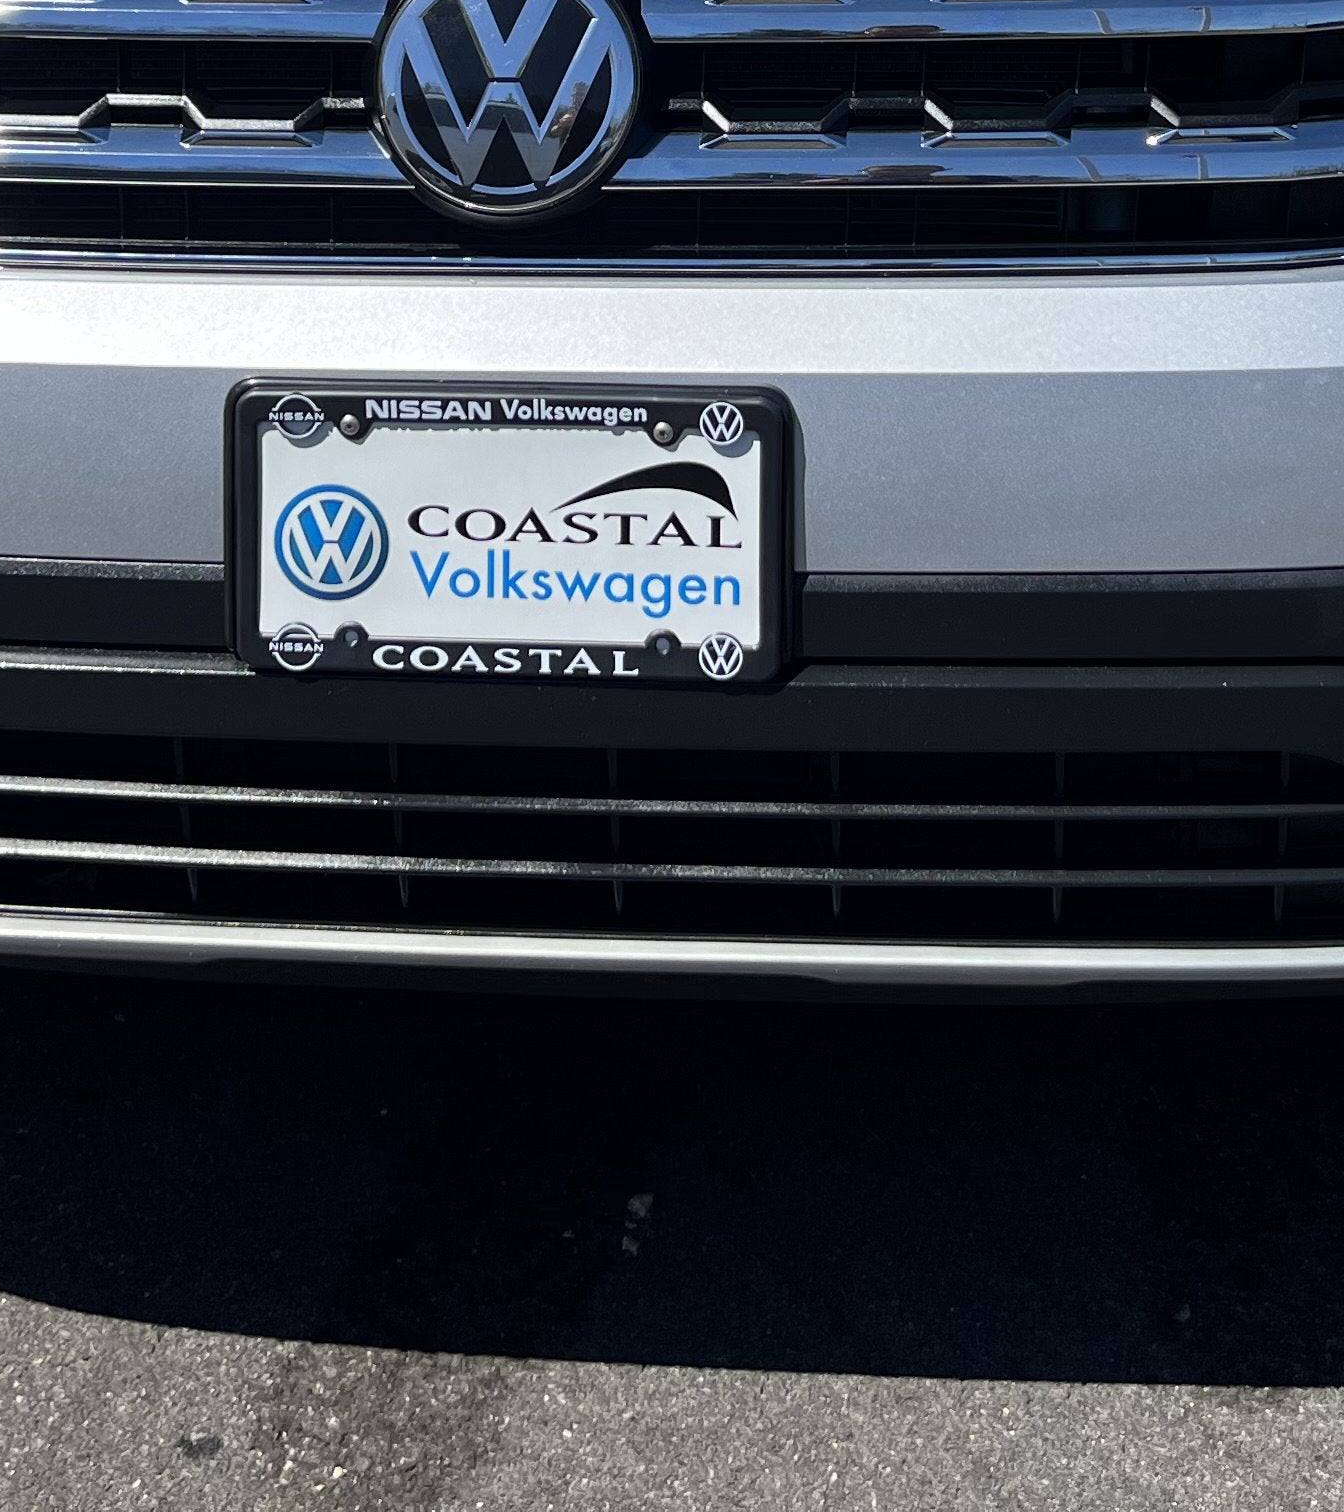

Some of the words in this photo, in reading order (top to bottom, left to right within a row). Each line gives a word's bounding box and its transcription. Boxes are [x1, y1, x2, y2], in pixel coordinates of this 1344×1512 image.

[268, 411, 325, 421] NISSAN
[365, 398, 492, 421] NISSAN
[500, 399, 647, 425] Volkswagen
[407, 505, 742, 549] COASTAL
[409, 548, 741, 619] Volkswagen
[268, 641, 324, 653] NISSAN
[372, 644, 640, 676] COASTAL
